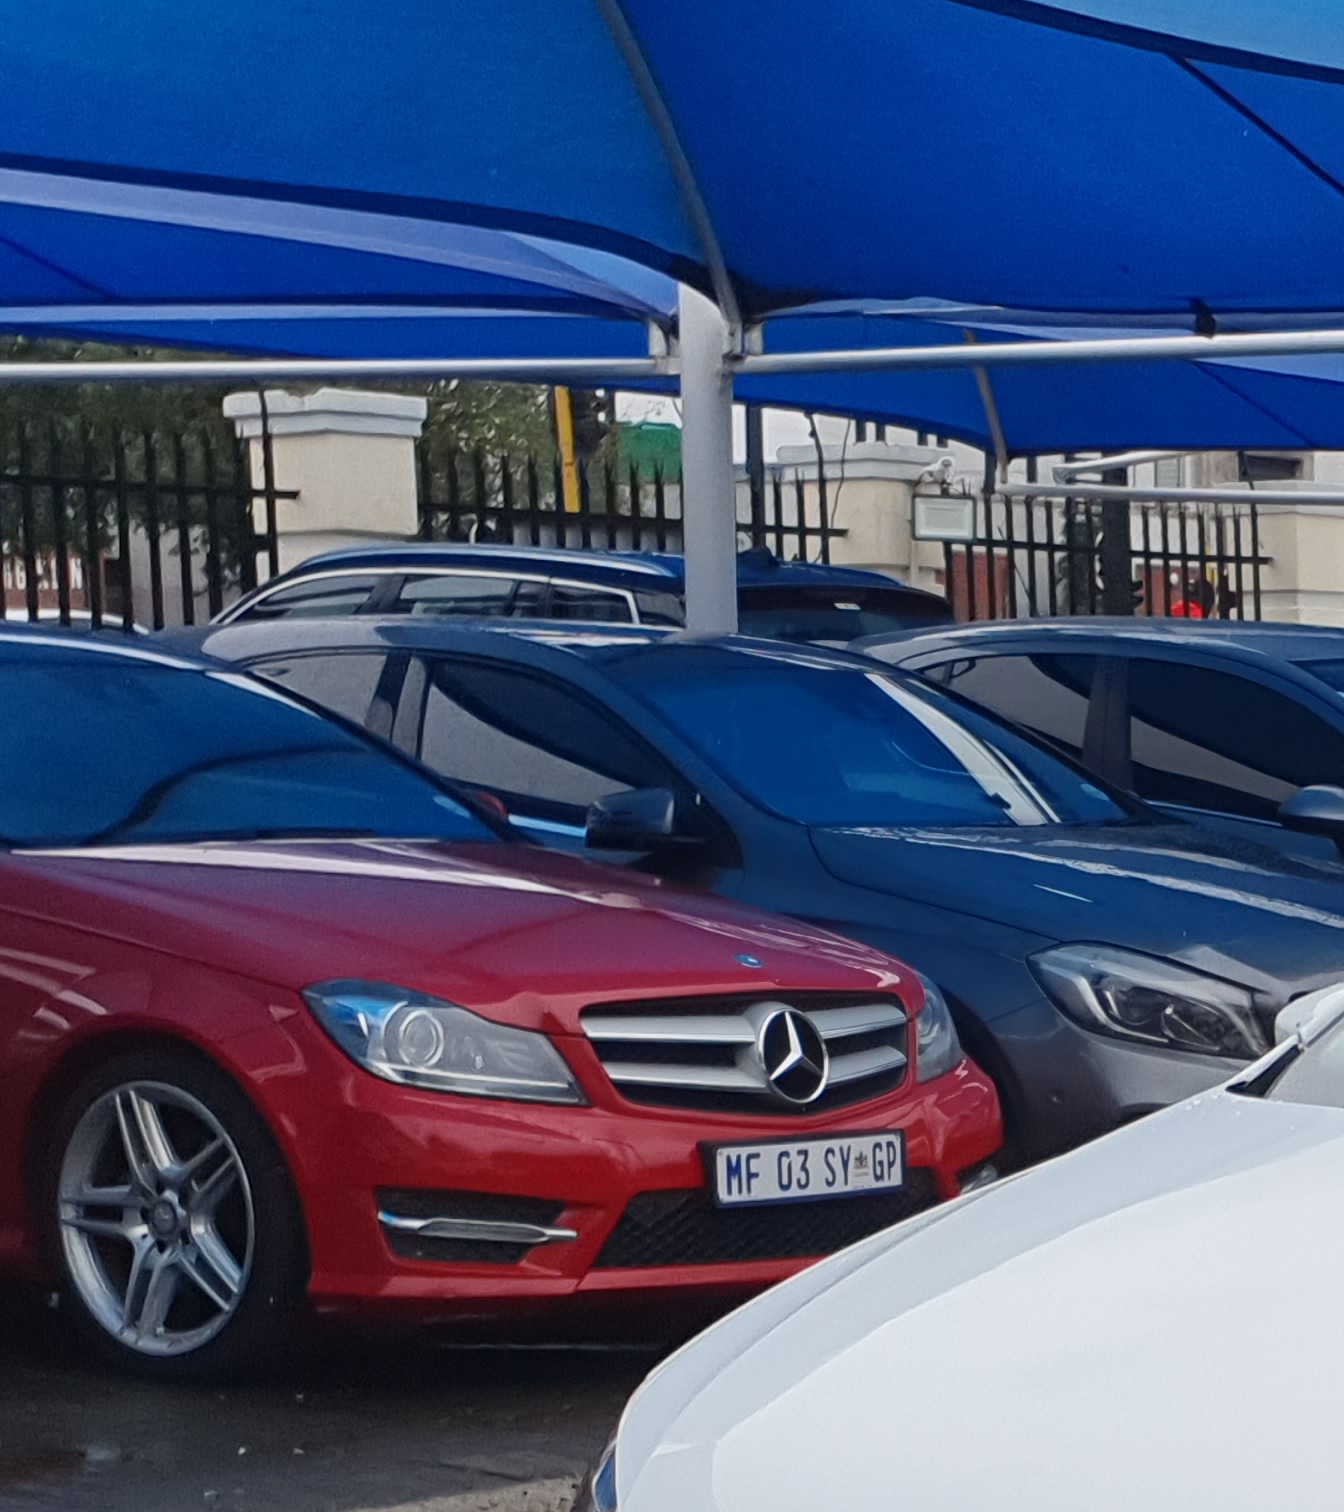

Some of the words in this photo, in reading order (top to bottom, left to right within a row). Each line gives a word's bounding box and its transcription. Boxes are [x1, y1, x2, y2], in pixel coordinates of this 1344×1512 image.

[725, 1152, 761, 1196] MF
[776, 1150, 810, 1192] 03
[824, 1144, 852, 1188] SY
[871, 1140, 897, 1182] GP
